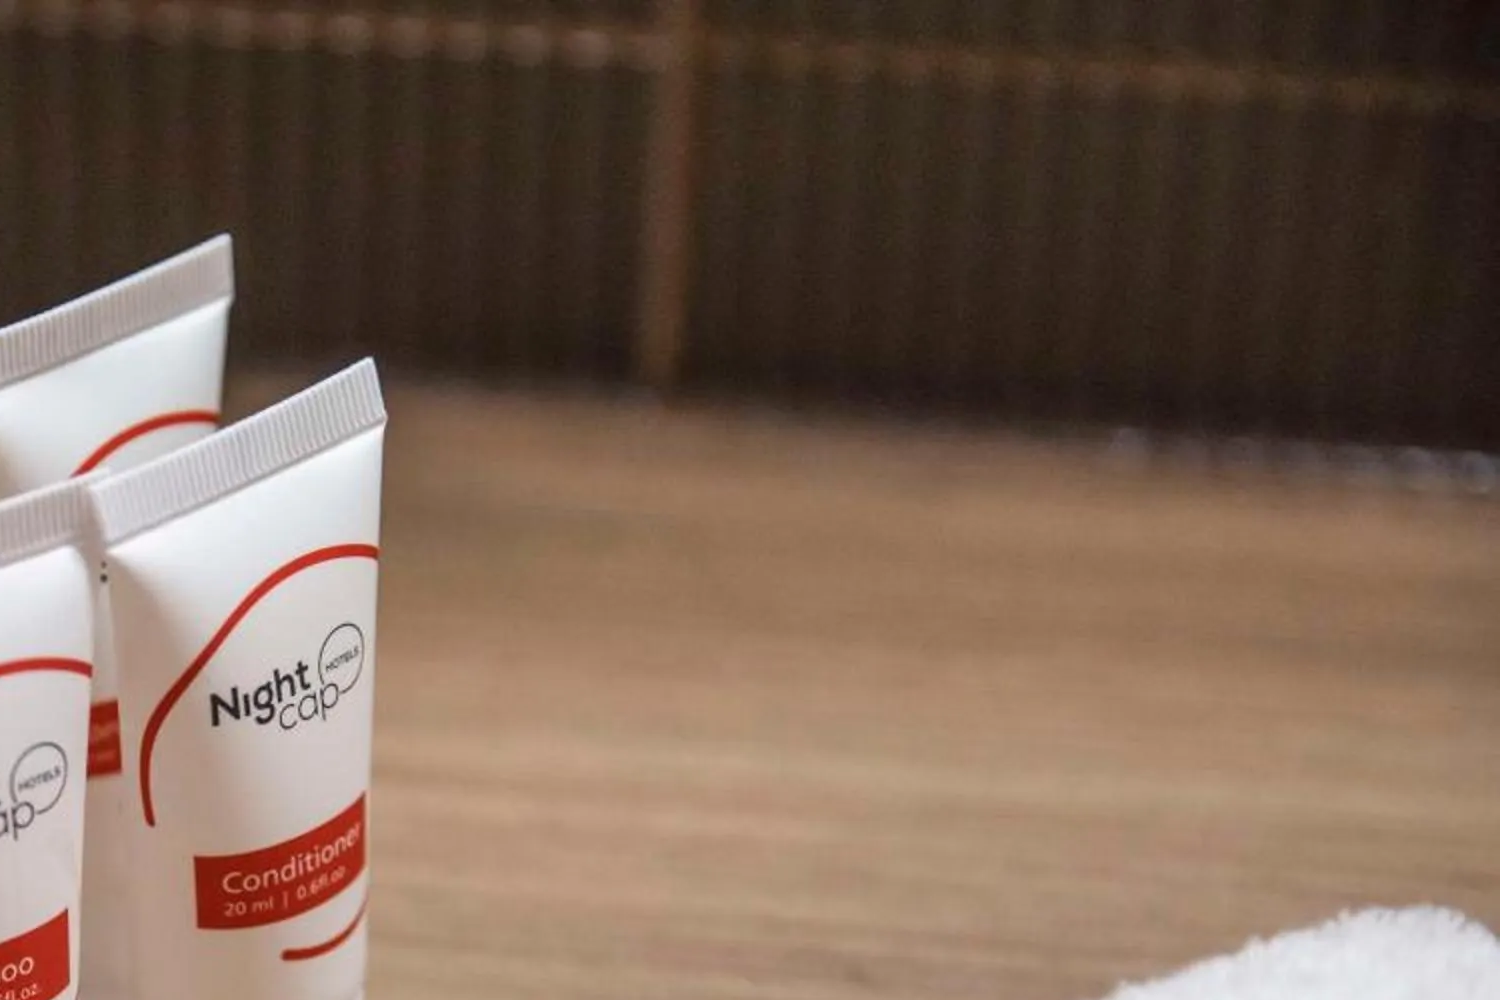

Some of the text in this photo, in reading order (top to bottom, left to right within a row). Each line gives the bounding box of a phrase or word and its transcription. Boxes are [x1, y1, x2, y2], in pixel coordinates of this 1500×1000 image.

[209, 660, 311, 727] Night
[279, 683, 339, 730] cap
[17, 766, 61, 792] HOTELS
[222, 823, 361, 894] Conditioner
[224, 901, 246, 917] 20
[252, 896, 274, 913] ml
